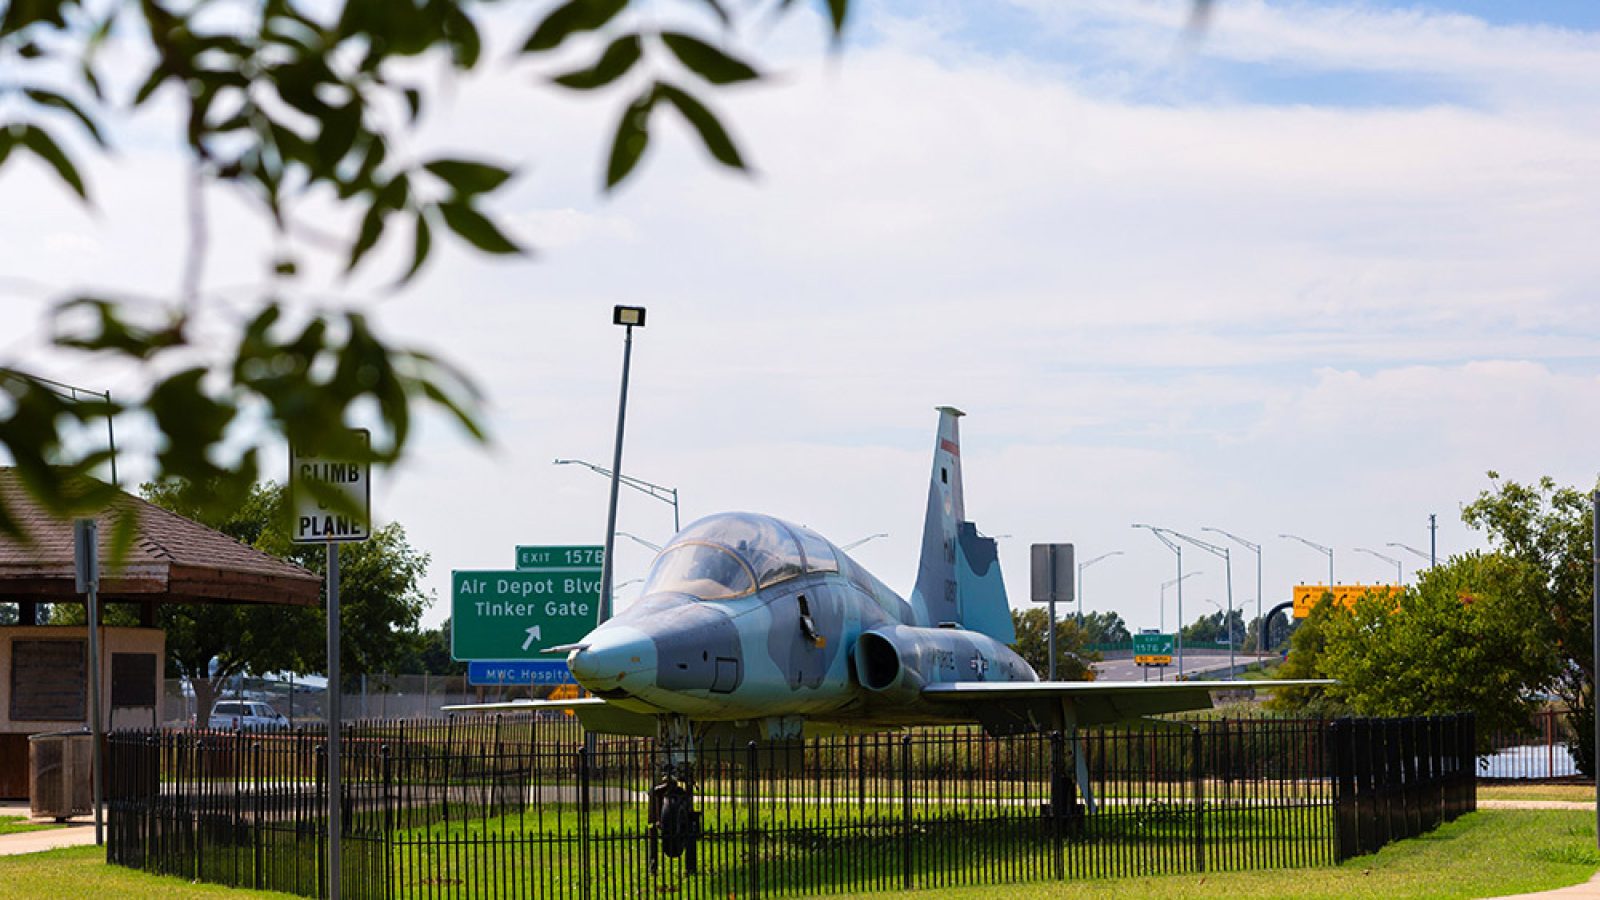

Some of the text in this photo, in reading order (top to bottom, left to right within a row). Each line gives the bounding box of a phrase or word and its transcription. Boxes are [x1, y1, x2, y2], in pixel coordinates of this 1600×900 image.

[301, 463, 360, 482] CLIMB
[299, 515, 361, 536] PLANE
[522, 549, 604, 564] EXIT 157B
[460, 579, 487, 594] Air
[497, 578, 553, 597] Depot
[475, 602, 589, 616] Tinker Gate
[486, 669, 572, 681] MWC Hospita
